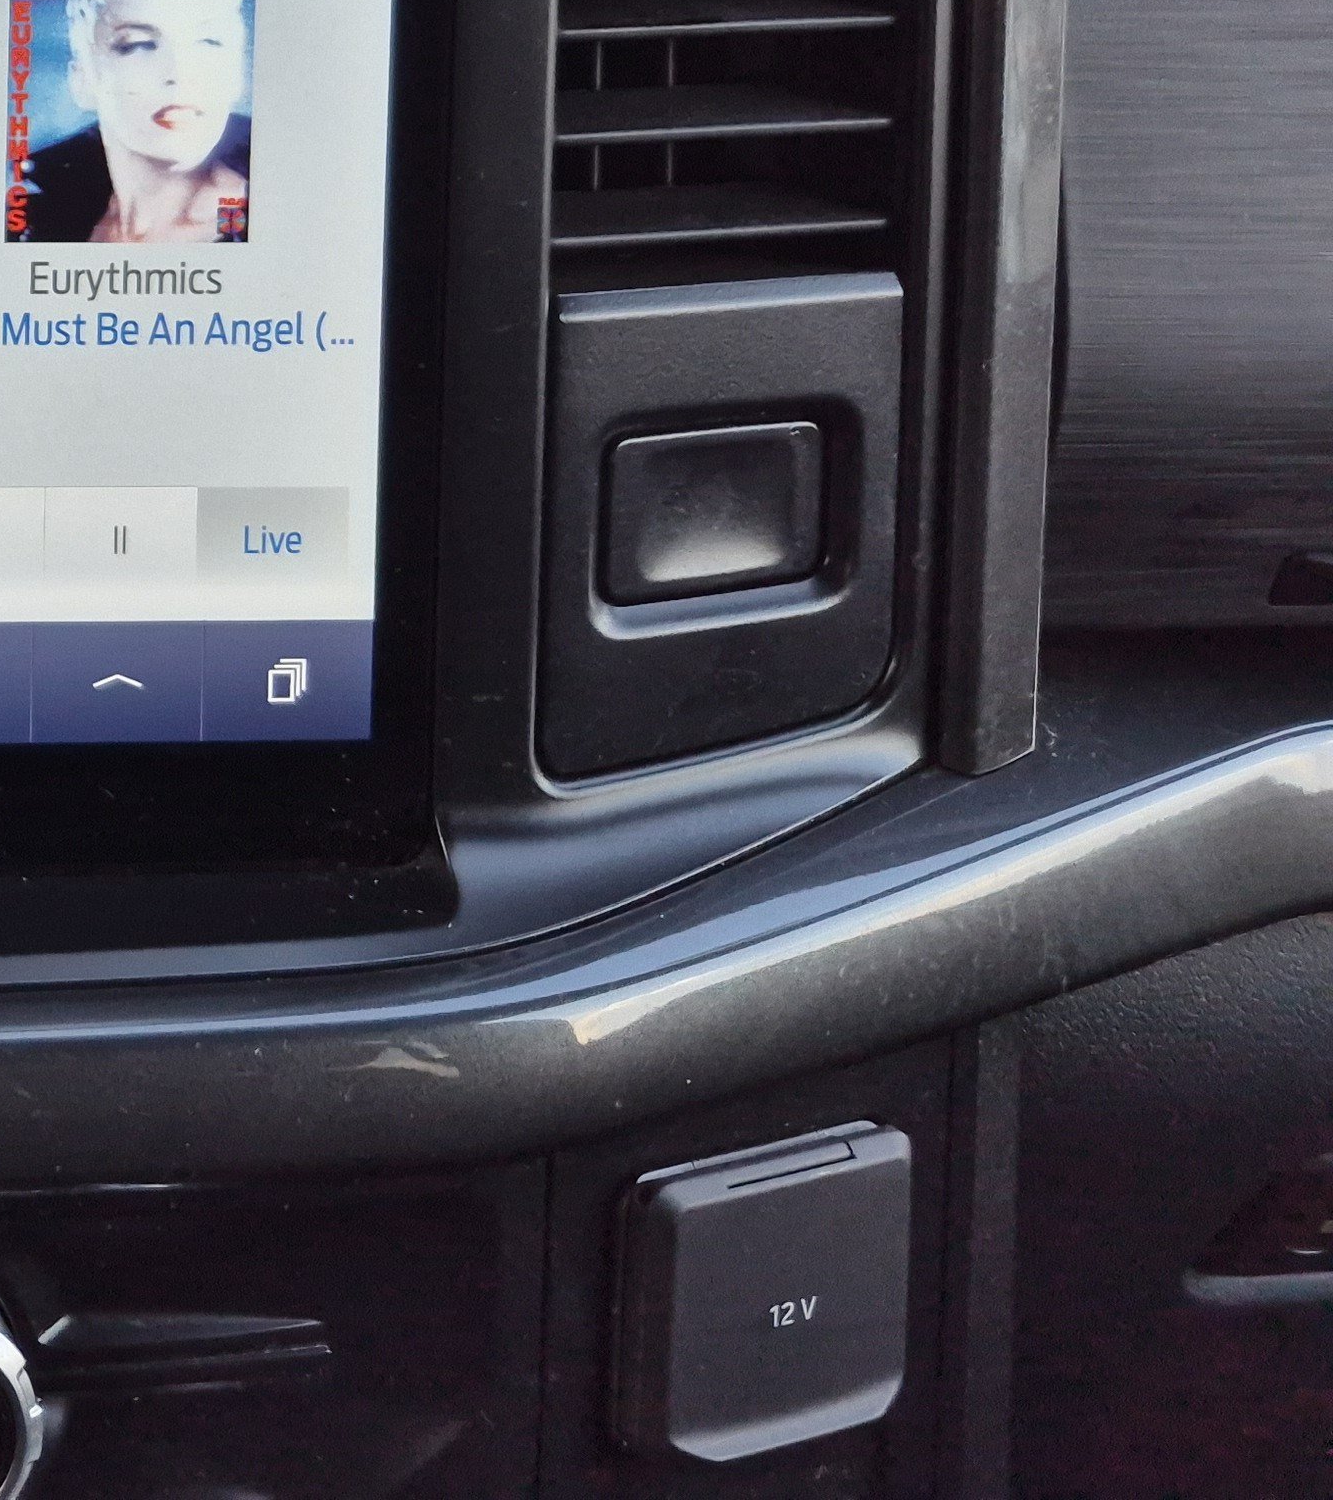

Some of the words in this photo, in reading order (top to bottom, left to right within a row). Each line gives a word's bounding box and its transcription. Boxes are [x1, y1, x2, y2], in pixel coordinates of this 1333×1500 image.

[29, 261, 223, 301] Eurythmics
[1, 313, 86, 347] Must
[96, 313, 139, 347] Be
[149, 313, 195, 347] An
[204, 311, 305, 353] Angel
[242, 524, 303, 556] Live
[769, 1301, 795, 1328] 12
[800, 1295, 817, 1320] V
